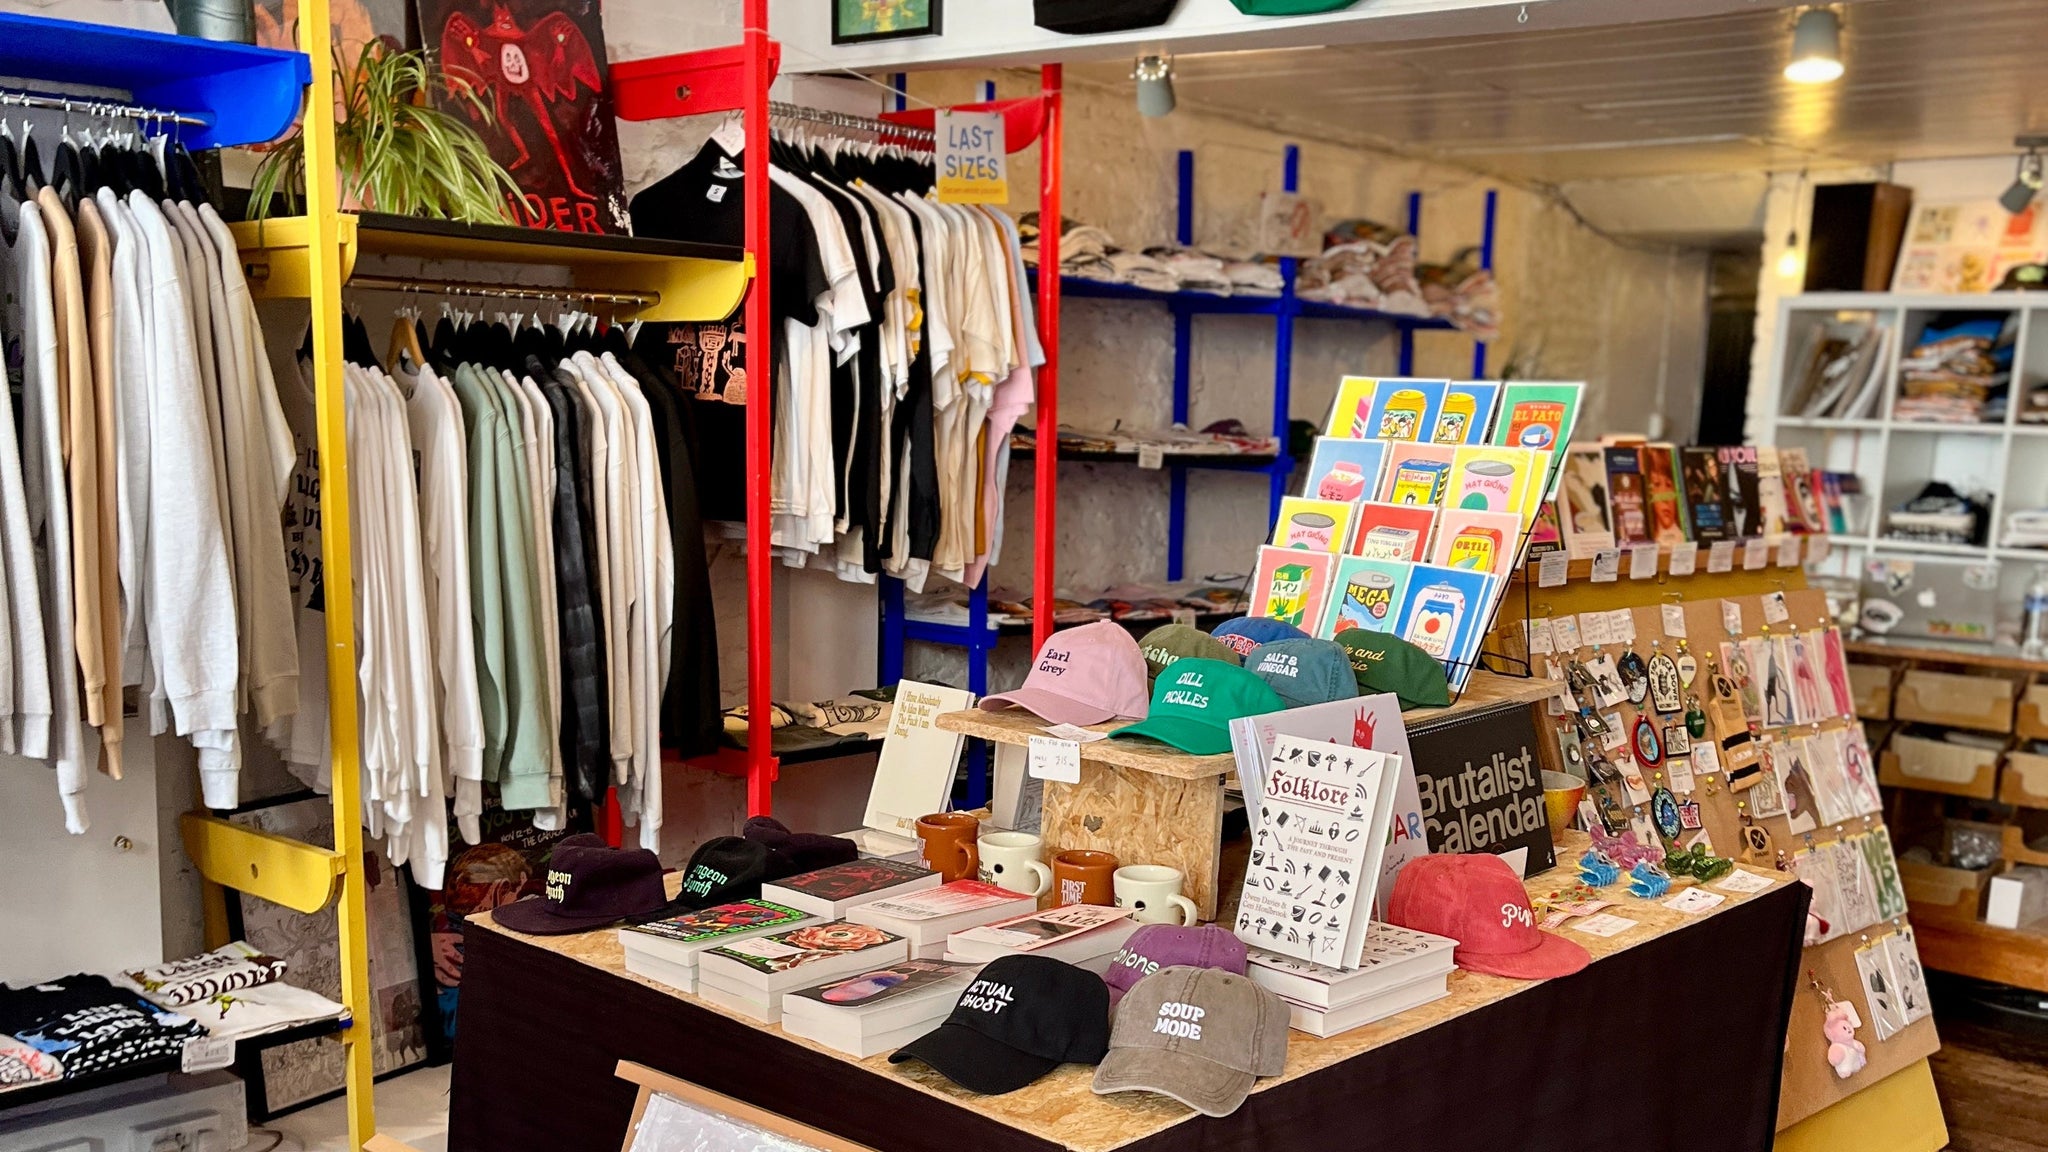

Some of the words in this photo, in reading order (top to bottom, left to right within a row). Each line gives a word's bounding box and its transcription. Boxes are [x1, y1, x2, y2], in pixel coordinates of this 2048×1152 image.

[949, 125, 994, 152] LAST
[945, 154, 999, 181] SIZES
[1514, 410, 1528, 421] EL
[1531, 410, 1562, 422] PATO
[1456, 541, 1489, 551] ORTIZ
[1348, 584, 1390, 606] MEGA
[1045, 649, 1070, 662] Earl
[1143, 644, 1179, 667] tcha
[1264, 653, 1288, 664] SALT
[1287, 656, 1298, 666] &
[1355, 648, 1385, 661] and
[1039, 660, 1066, 676] Grey
[1257, 663, 1299, 678] VINEGAR
[1351, 660, 1368, 670] nic
[1176, 672, 1203, 687] DILL
[1162, 690, 1209, 709] PICKLES
[1267, 769, 1349, 806] Folklore
[1416, 746, 1536, 818] Brutalist
[1425, 792, 1546, 855] Calendar
[521, 836, 537, 848] THE
[1293, 837, 1318, 848] JOURNEY
[1320, 842, 1348, 854] THROUGH
[1287, 844, 1299, 852] THE
[1300, 846, 1314, 855] PAST
[1314, 850, 1327, 858] AND
[1327, 852, 1353, 864] PRESENT
[693, 864, 728, 885] ngeon
[684, 874, 713, 898] Synth
[1061, 879, 1087, 893] FIRST
[1061, 891, 1083, 904] TIME
[1244, 892, 1260, 902] Owen
[1262, 896, 1281, 907] Davies
[1113, 947, 1160, 976] nions
[967, 980, 1014, 1001] ACTUAL
[960, 994, 1007, 1014] GHOST
[1159, 1001, 1205, 1022] SOUP
[1153, 1018, 1202, 1040] MODE
